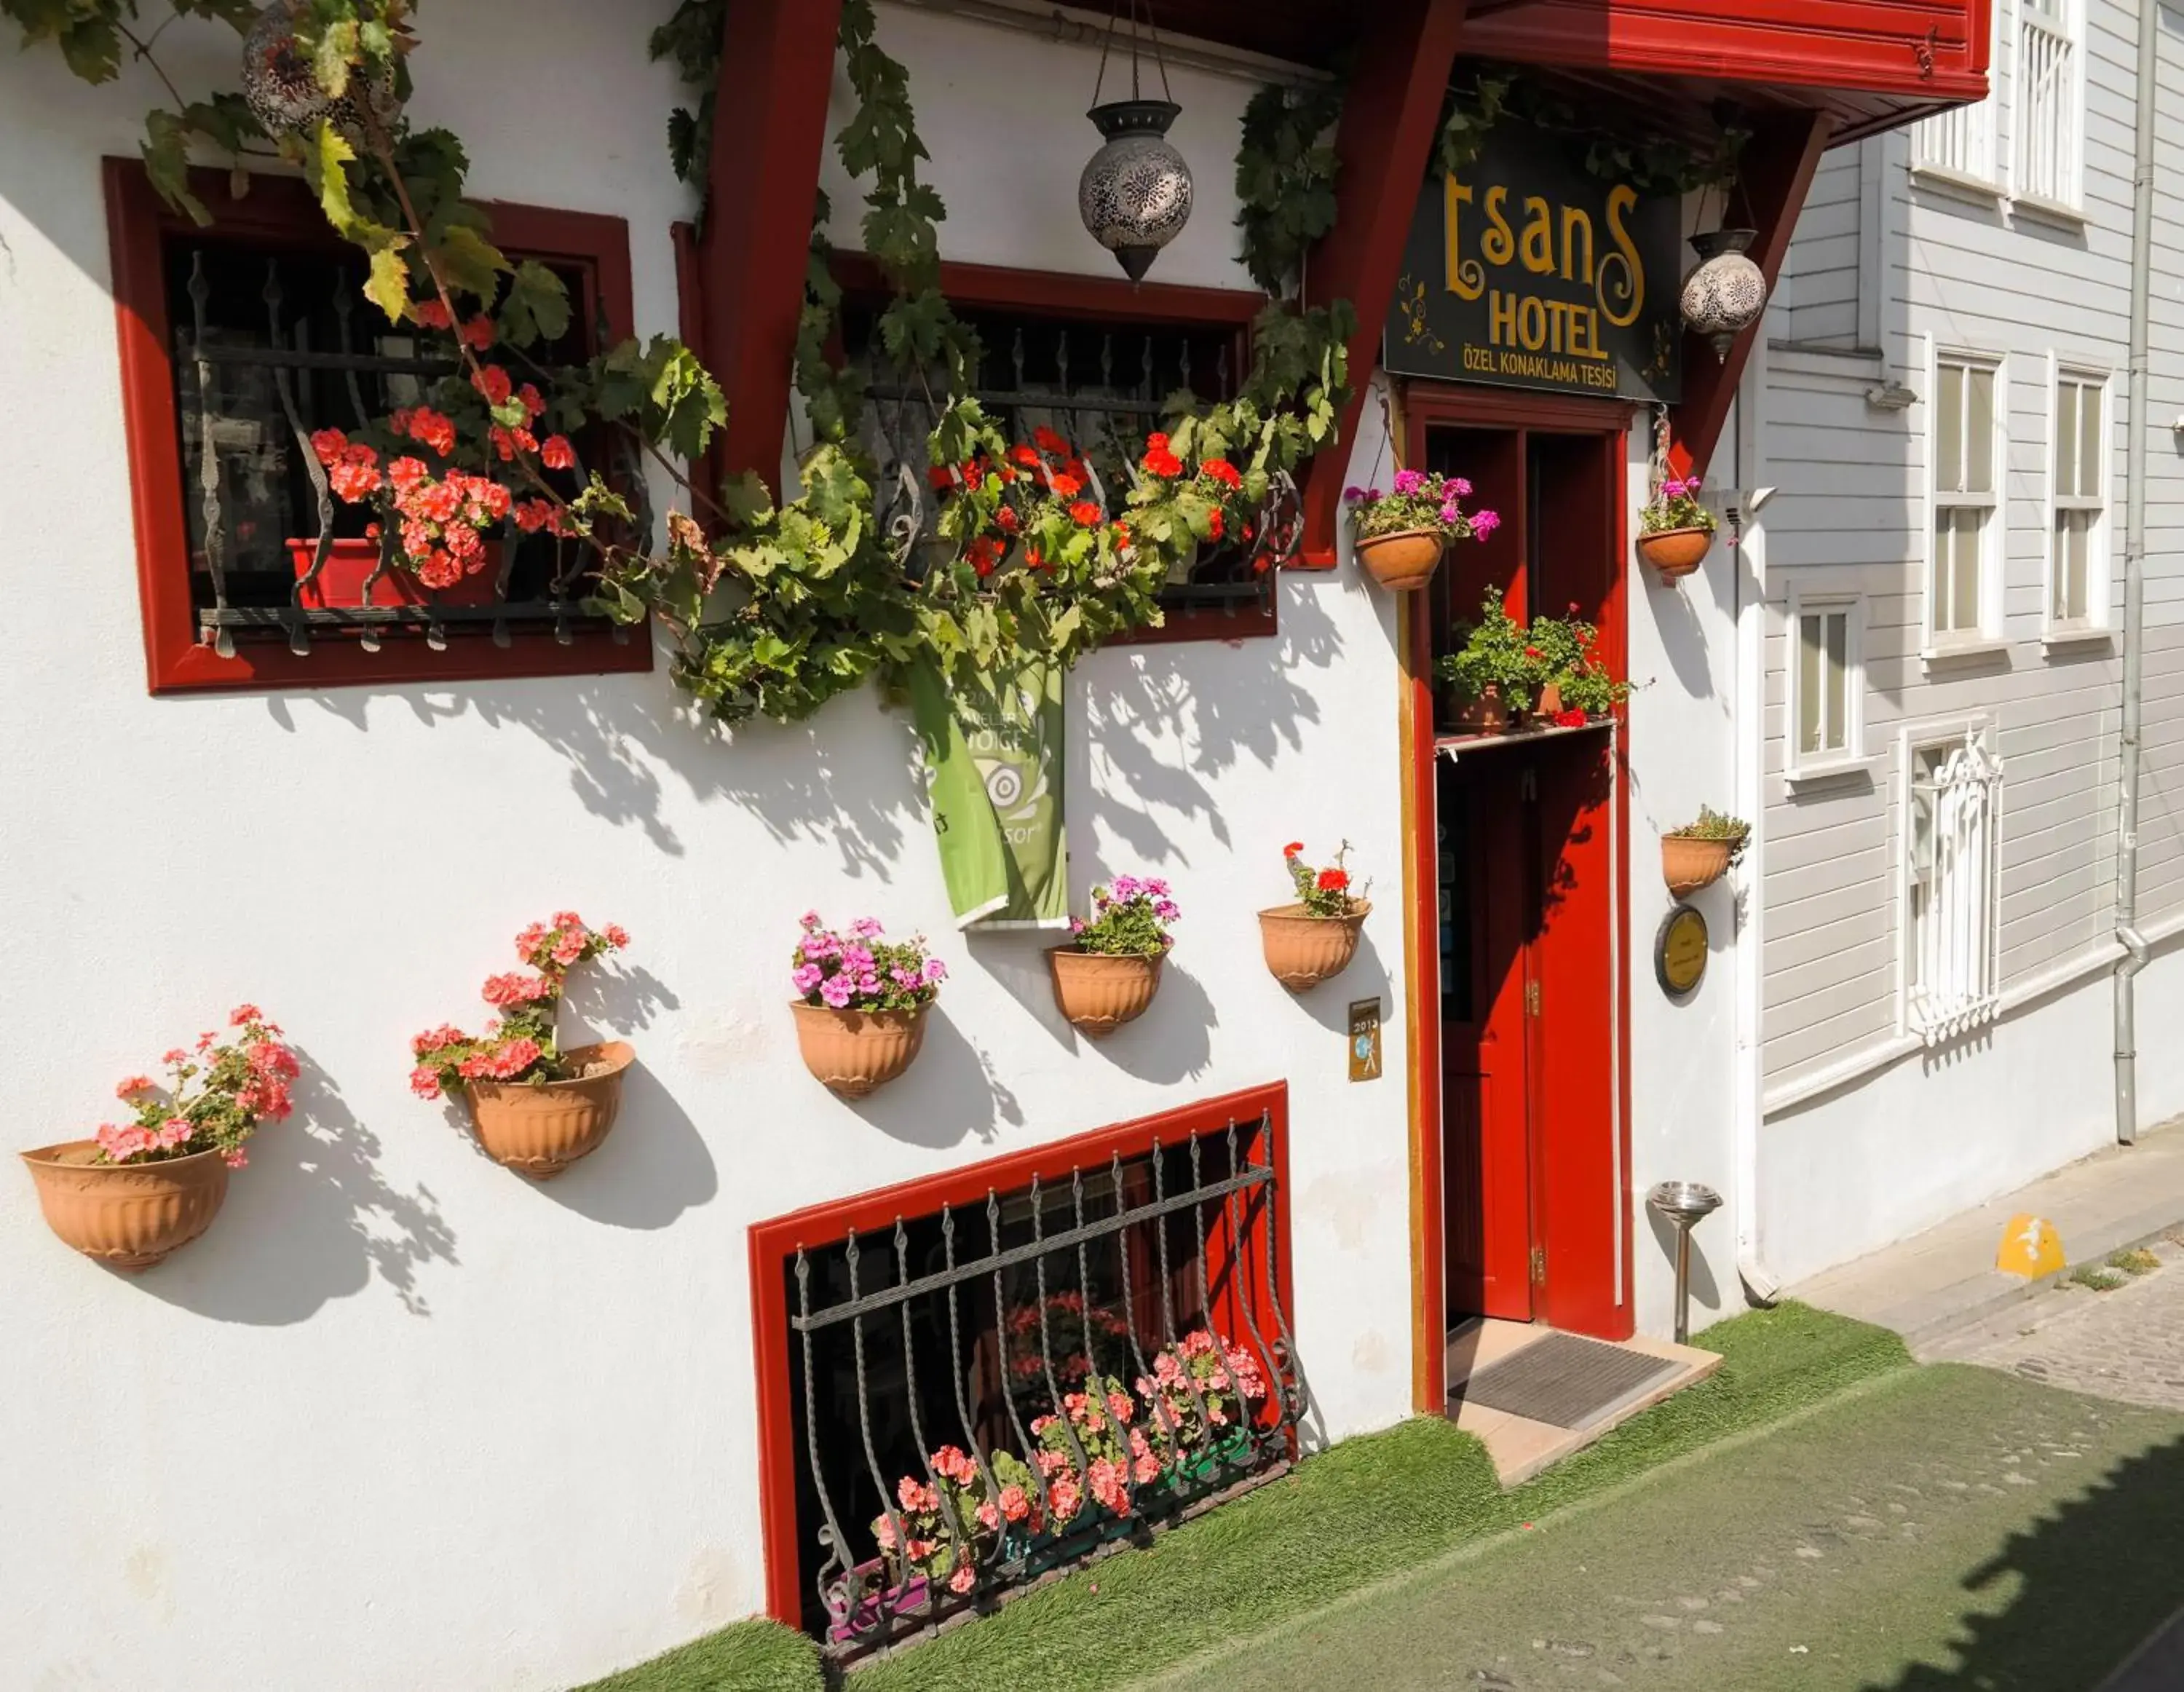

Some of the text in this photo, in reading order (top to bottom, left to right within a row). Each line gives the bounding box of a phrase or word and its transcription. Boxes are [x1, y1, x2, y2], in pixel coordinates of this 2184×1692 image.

[1489, 289, 1608, 359] HOTEL
[1464, 343, 1616, 389] ÖZEL KONAKLAMA TESİSİ
